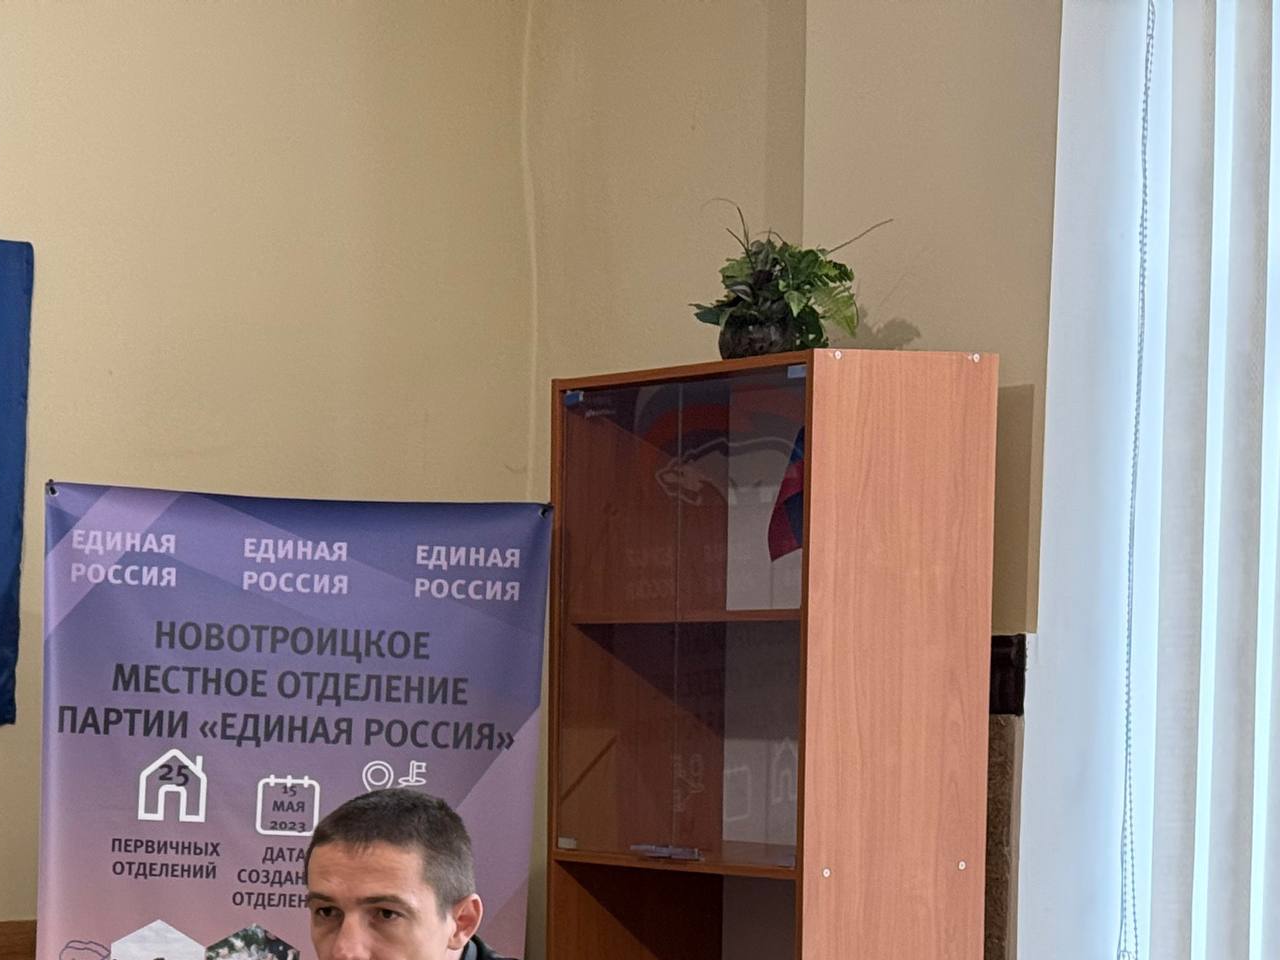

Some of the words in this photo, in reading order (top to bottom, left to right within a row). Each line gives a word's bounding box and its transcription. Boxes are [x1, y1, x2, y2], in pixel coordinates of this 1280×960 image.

[71, 529, 177, 556] ЕДИНАЯ
[243, 537, 348, 564] ЕДИНАЯ
[416, 545, 520, 571] ЕДИНАЯ
[71, 563, 177, 587] РОССИЯ
[242, 571, 348, 594] РОССИЯ
[414, 578, 520, 601] РОССИЯ
[155, 620, 430, 664] НОВОТРОИЦКОЕ
[112, 663, 268, 697] МЕСТНОЕ
[277, 670, 469, 707] ОТДЕЛЕНИЕ
[57, 705, 189, 739] ПАРТИИ
[198, 712, 353, 748] «ЕДИНАЯ
[364, 718, 515, 751] РОССИЯ»
[158, 764, 190, 787] 25
[281, 785, 297, 797] 15
[272, 800, 306, 813] МАЯ
[269, 820, 306, 833] 2023
[111, 838, 221, 857] ПЕРВИЧНЫХ
[261, 846, 306, 864] ДАТА
[112, 861, 217, 880] ОТДЕЛЕНИЙ
[237, 868, 307, 888] СОЗДАН
[232, 891, 308, 910] ОТДЕЛЕН
